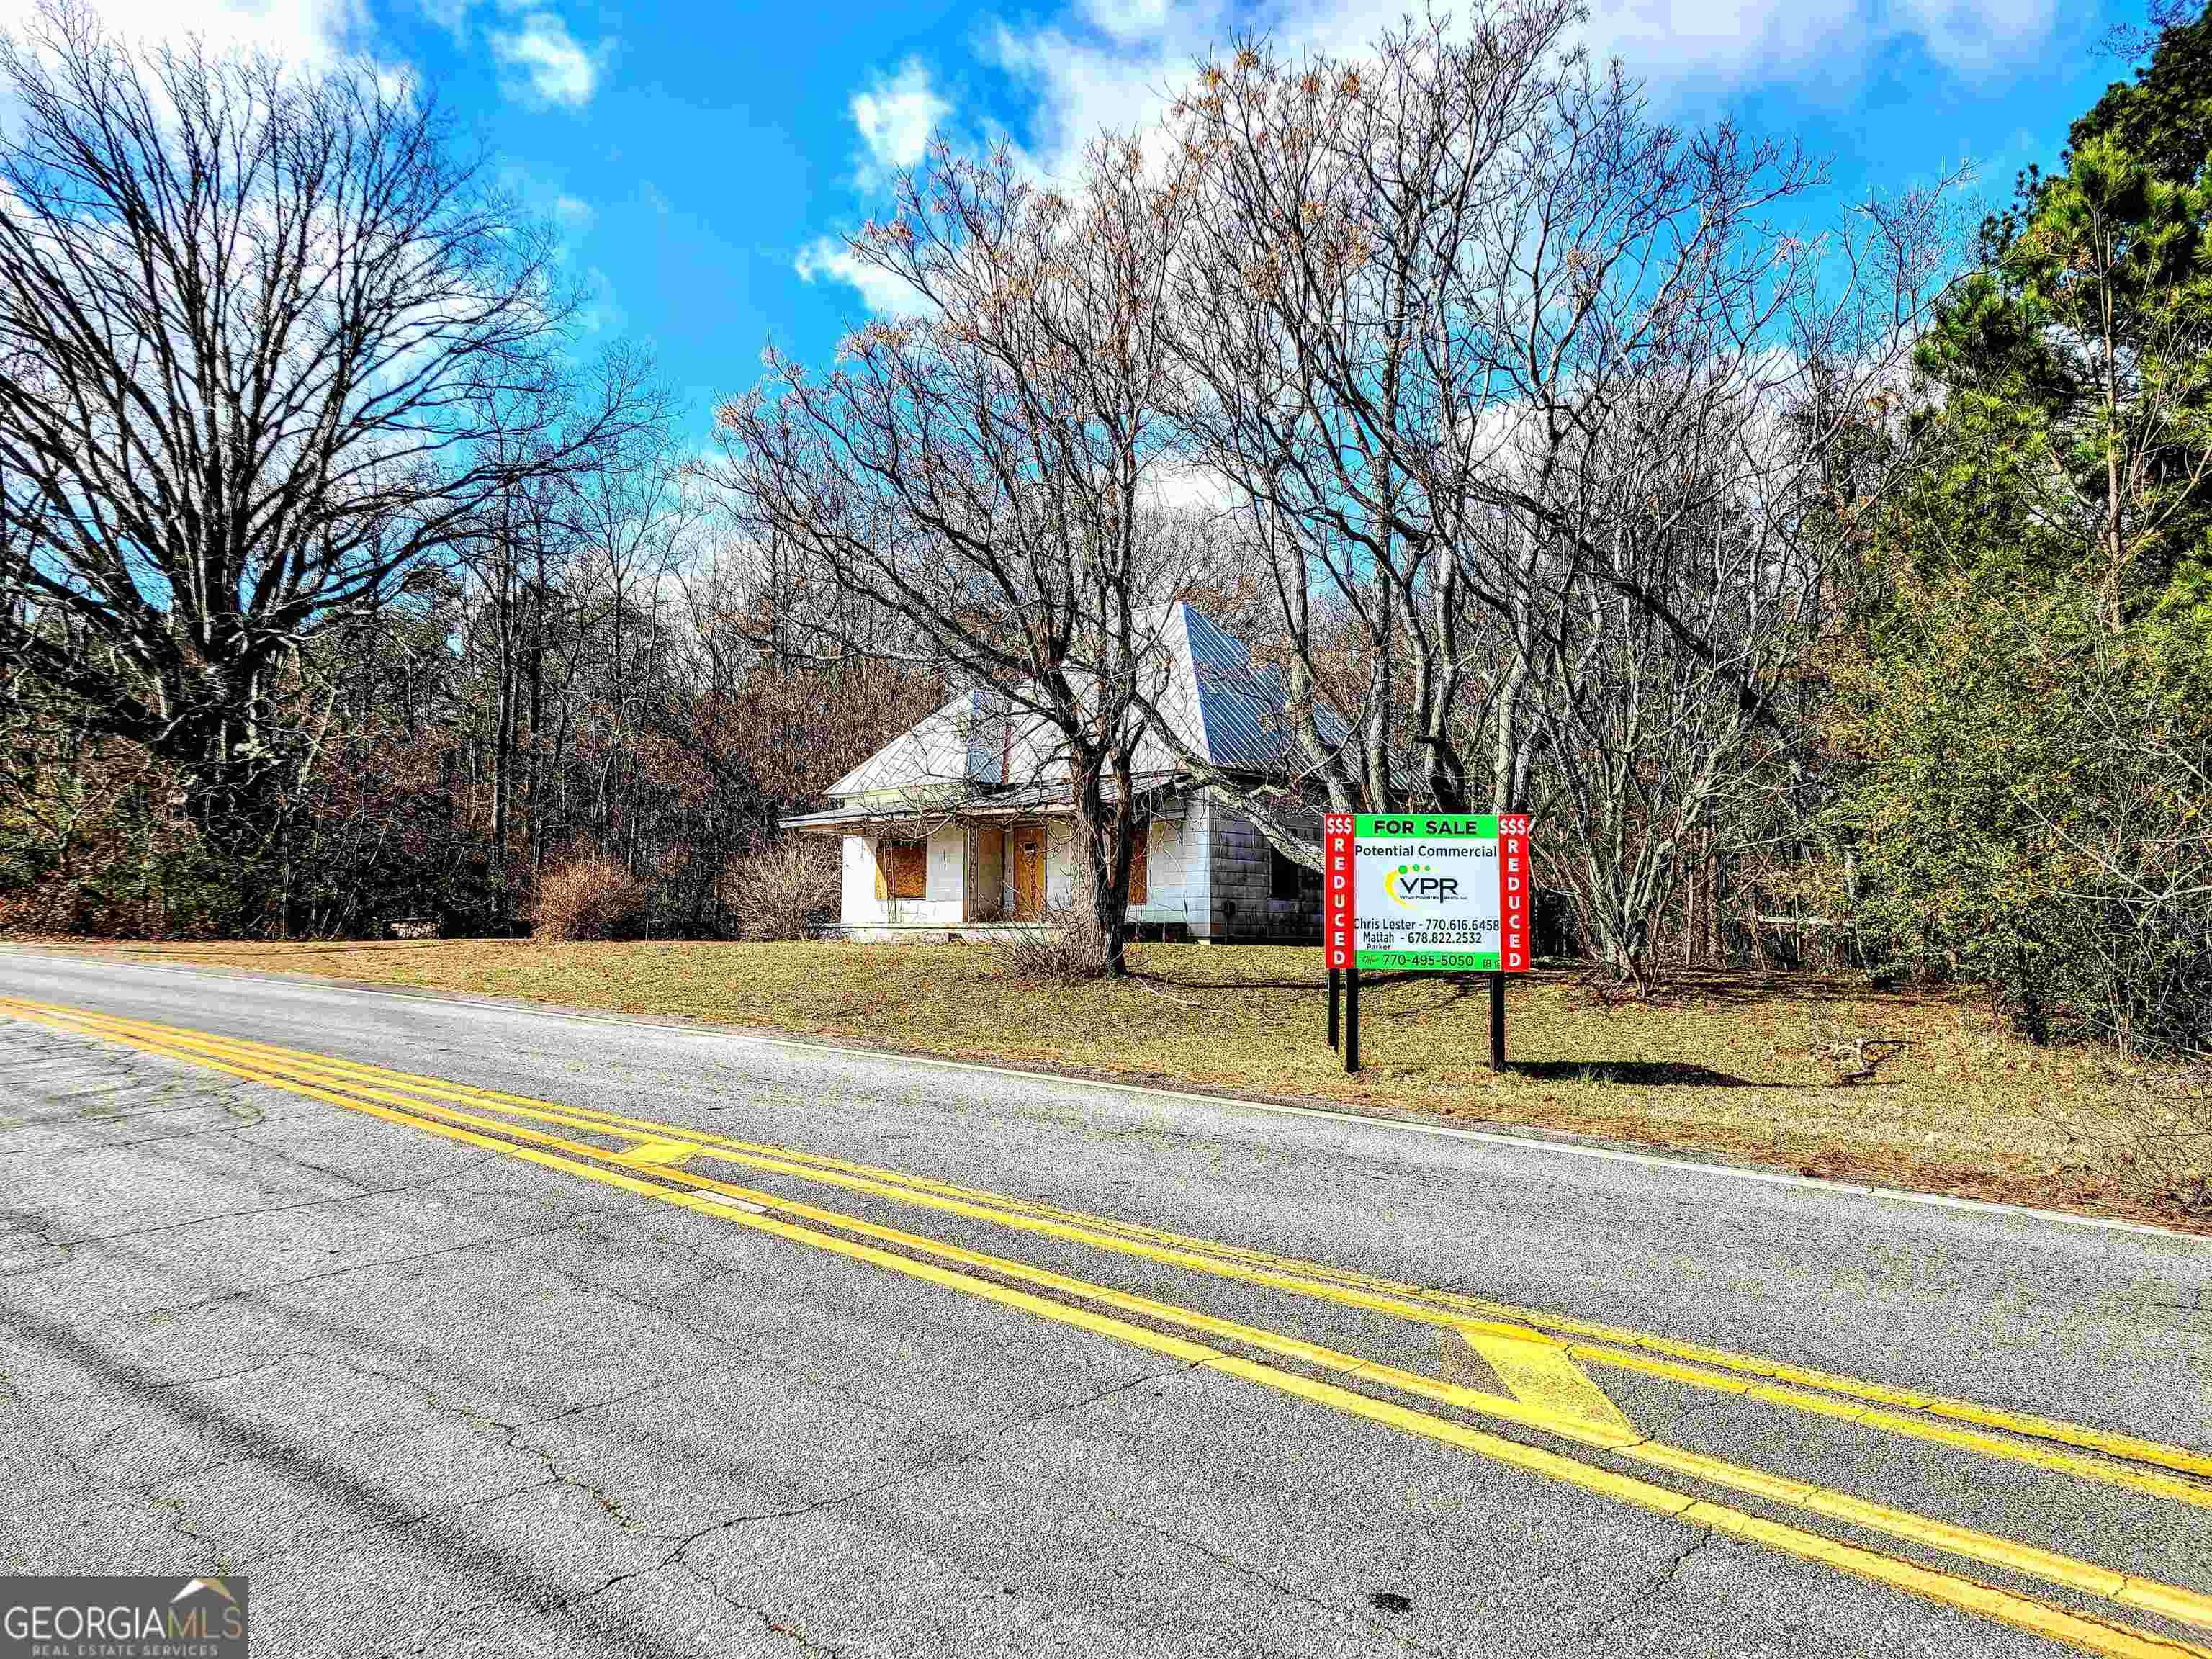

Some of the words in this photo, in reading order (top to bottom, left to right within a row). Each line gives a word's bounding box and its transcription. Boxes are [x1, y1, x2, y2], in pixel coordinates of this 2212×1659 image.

[1326, 819, 1352, 834] $$$
[1374, 820, 1414, 834] FOR
[1426, 821, 1477, 835] SALE
[1498, 819, 1526, 836] $$$
[1355, 845, 1413, 856] Potential
[1418, 845, 1498, 858] Commercial
[1400, 878, 1459, 903] VPR
[1333, 838, 1346, 965] REDUCED
[1507, 839, 1521, 967] REDUCED
[1354, 918, 1380, 930] Chris
[1382, 919, 1416, 930] Lester
[1426, 919, 1499, 930] 770.616.6458
[1363, 932, 1394, 943] Mattah
[1408, 932, 1482, 944] 678.822.2532
[1382, 955, 1474, 966] 770-495-5050
